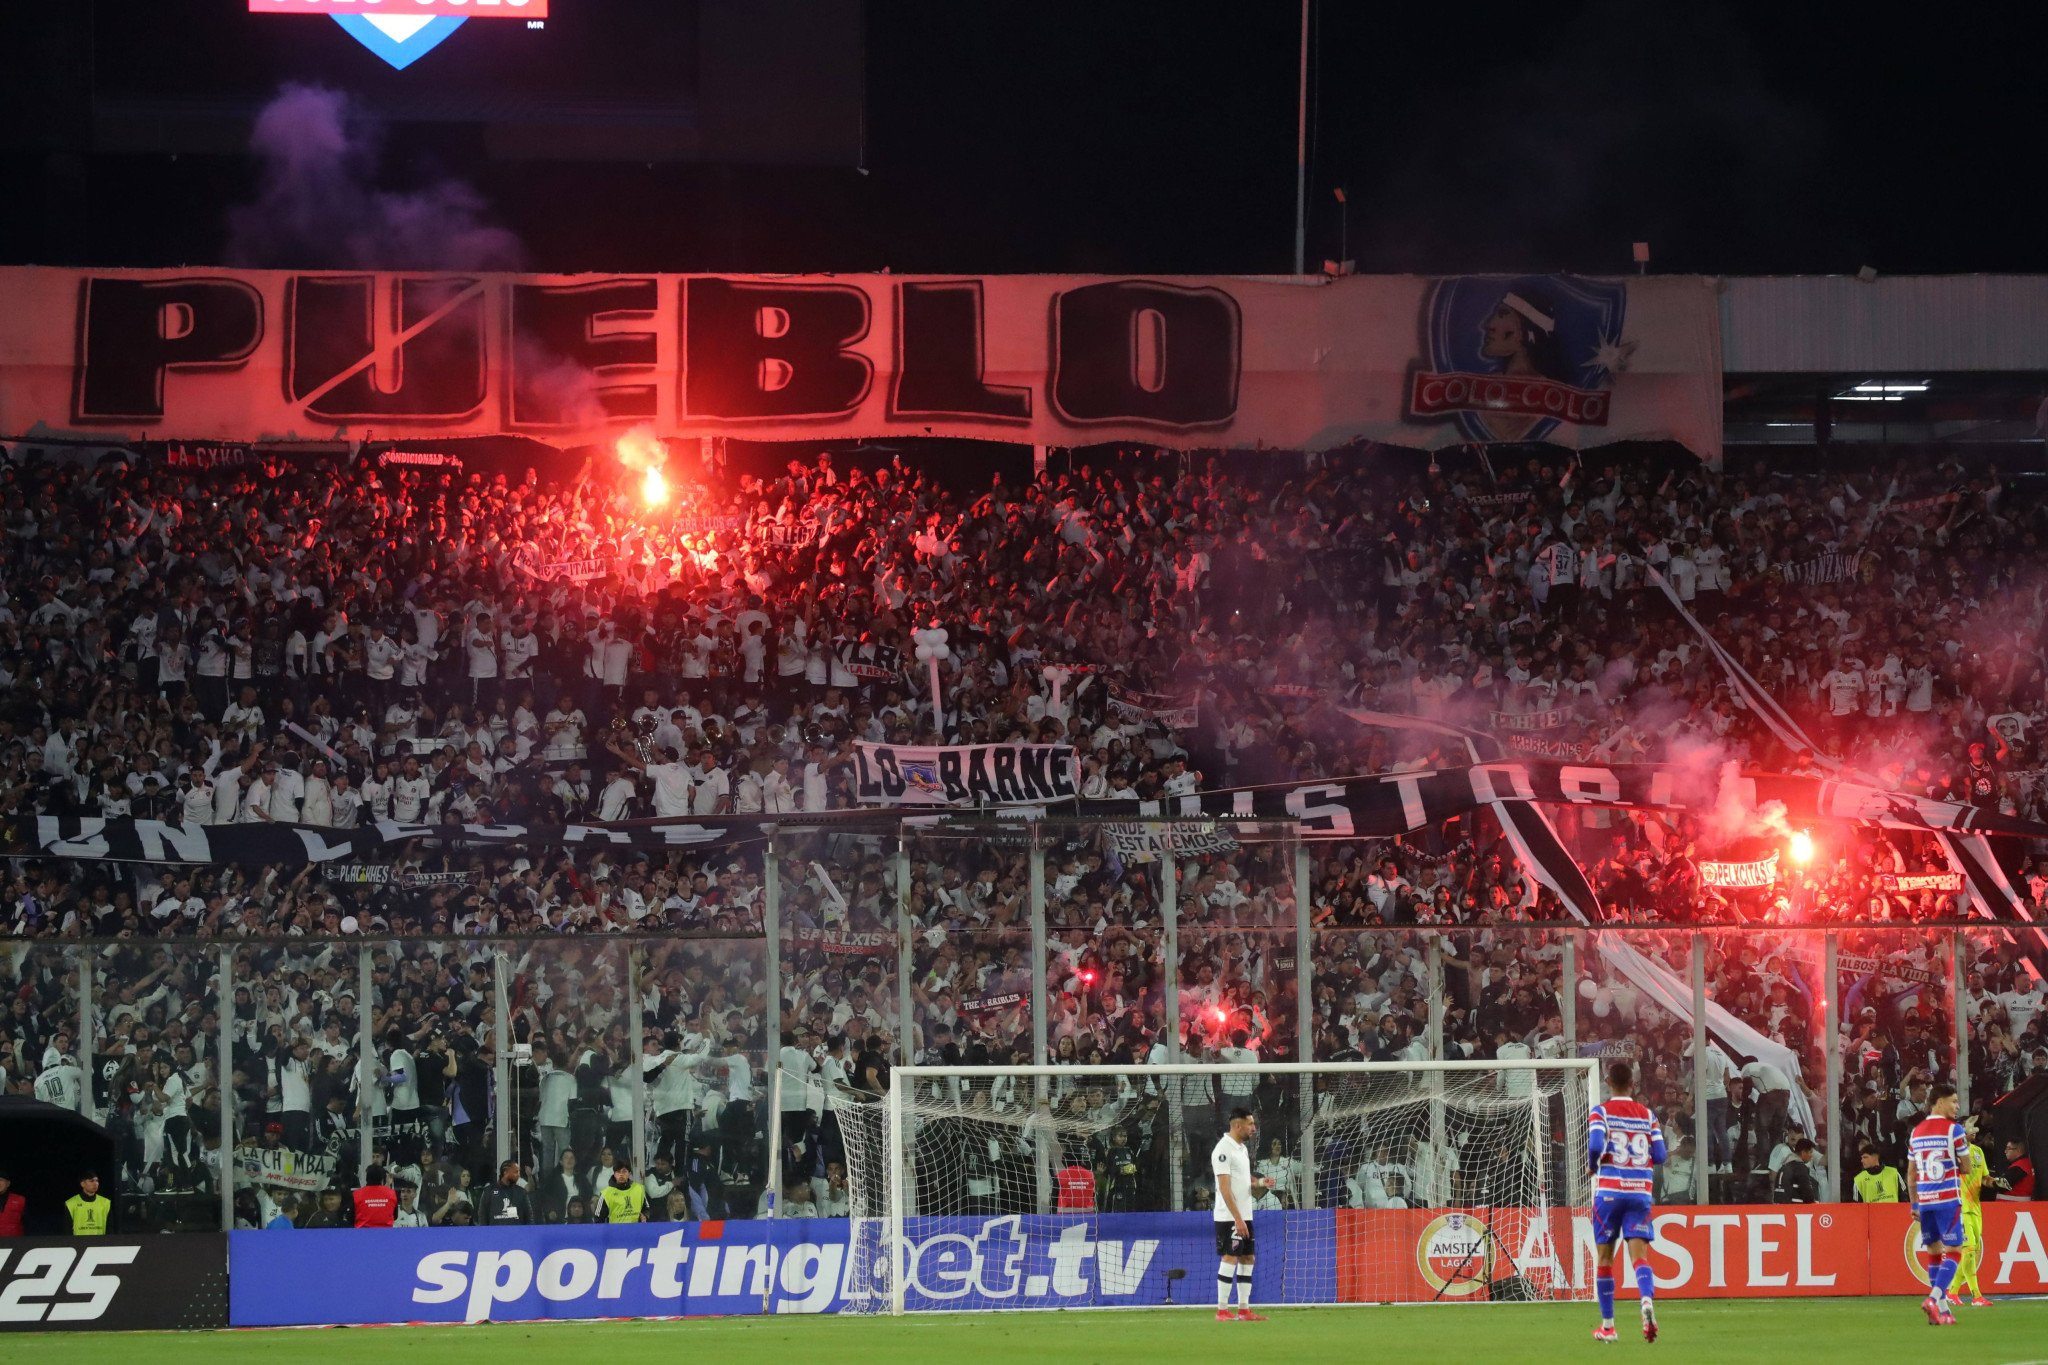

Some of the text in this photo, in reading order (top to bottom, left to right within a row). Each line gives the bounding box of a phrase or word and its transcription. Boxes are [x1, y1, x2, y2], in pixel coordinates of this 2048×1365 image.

[527, 21, 544, 29] MR
[72, 273, 1241, 429] PUEBLO
[1421, 378, 1603, 420] COLO-COLO
[568, 558, 604, 576] ITALIA
[857, 745, 1077, 802] LO BARNE
[1718, 860, 1768, 885] PELXCITAS
[963, 1000, 980, 1010] THE
[44, 1076, 63, 1097] 10
[1610, 1131, 1649, 1166] 39
[262, 1150, 325, 1175] CHMBA
[1914, 1150, 1946, 1182] 16
[1433, 1242, 1480, 1255] AMSTEL
[0, 1246, 140, 1321] 25
